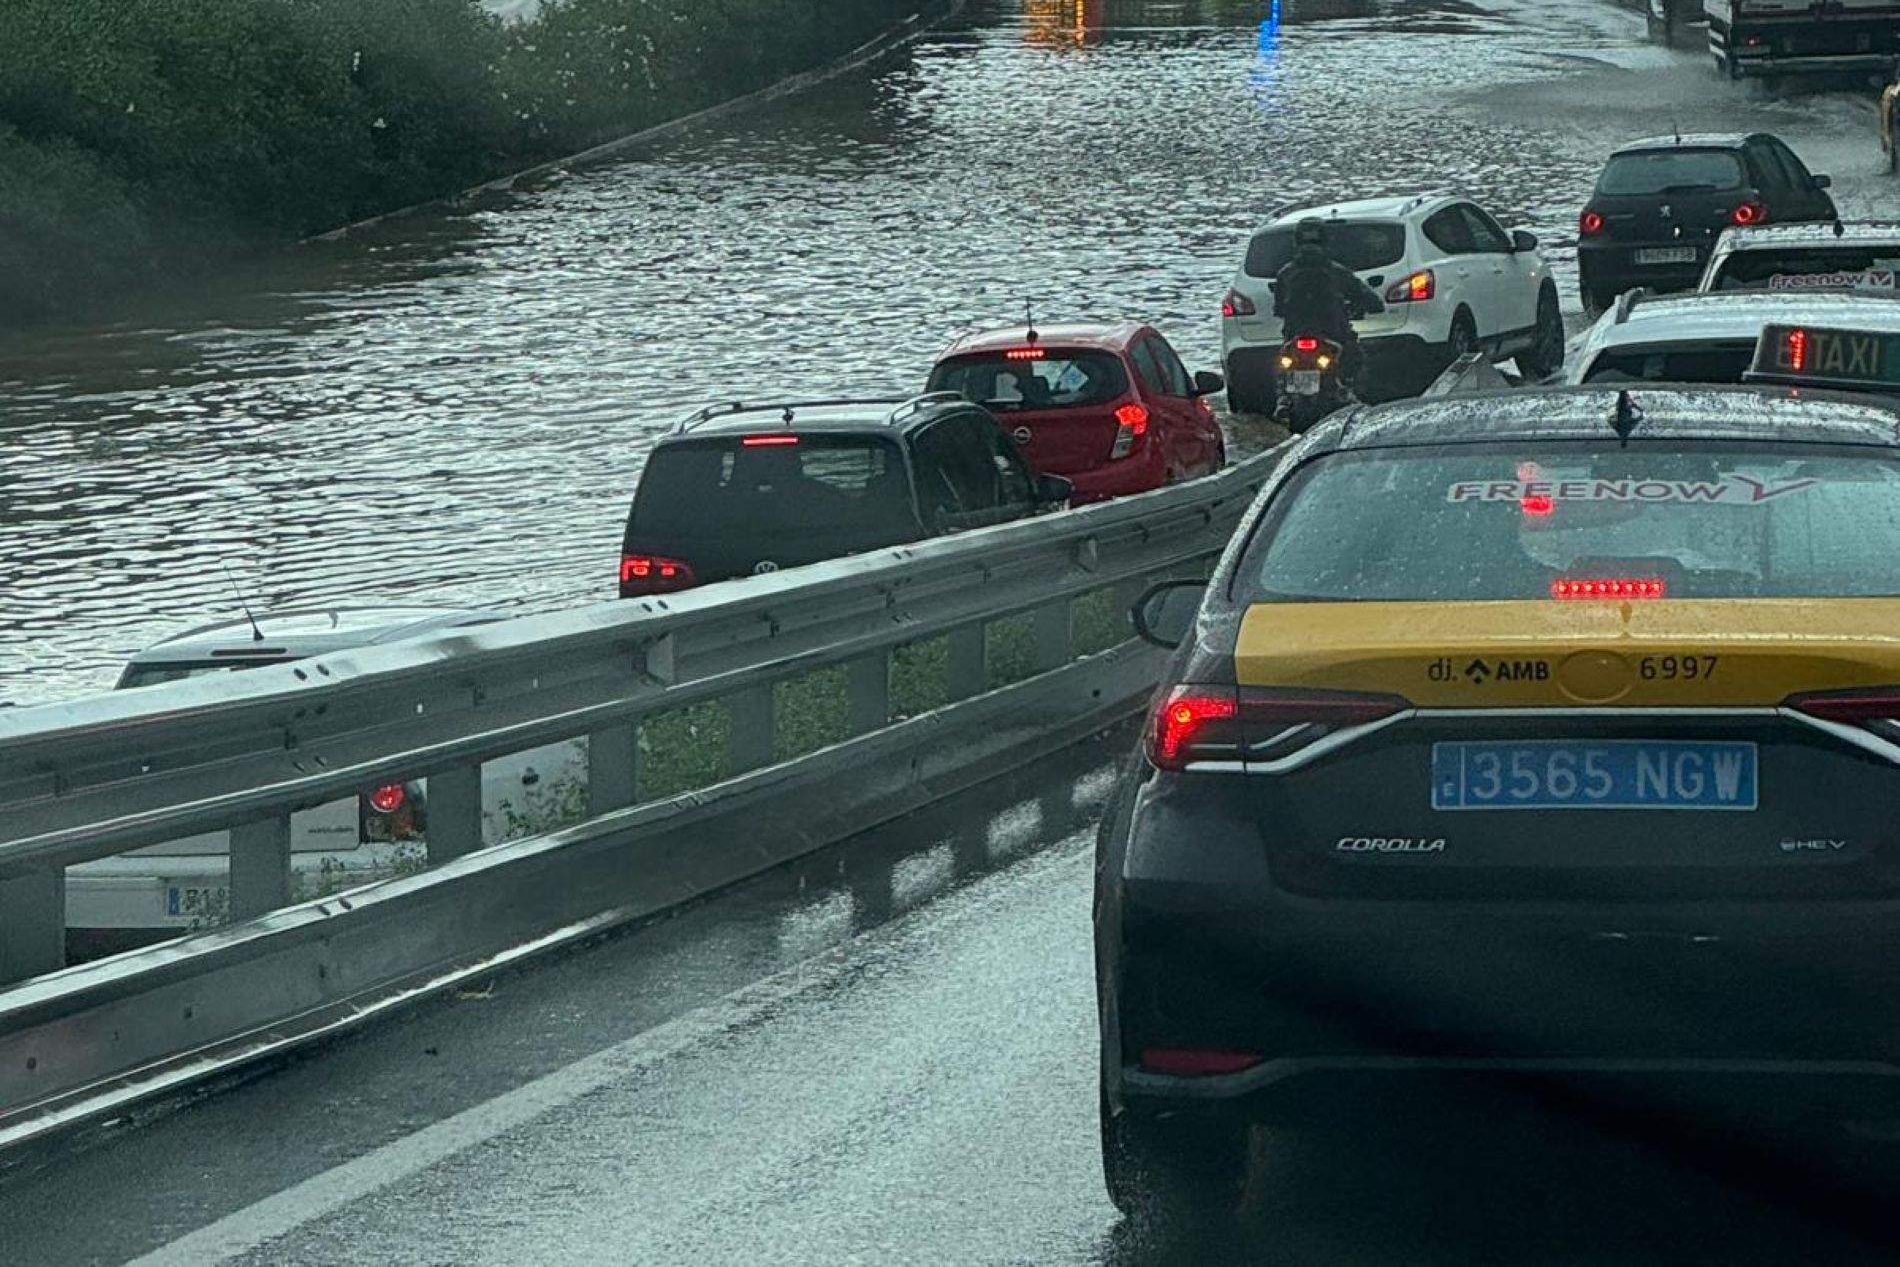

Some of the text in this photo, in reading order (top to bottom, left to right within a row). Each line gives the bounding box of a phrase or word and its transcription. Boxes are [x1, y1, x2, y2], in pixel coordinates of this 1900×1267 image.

[1813, 333, 1880, 374] TAXI
[1453, 481, 1728, 501] FREENOW
[1496, 659, 1549, 682] AMB
[1640, 656, 1718, 680] 6997
[1472, 750, 1743, 801] 3565 NGW
[1336, 837, 1446, 852] COROLLA
